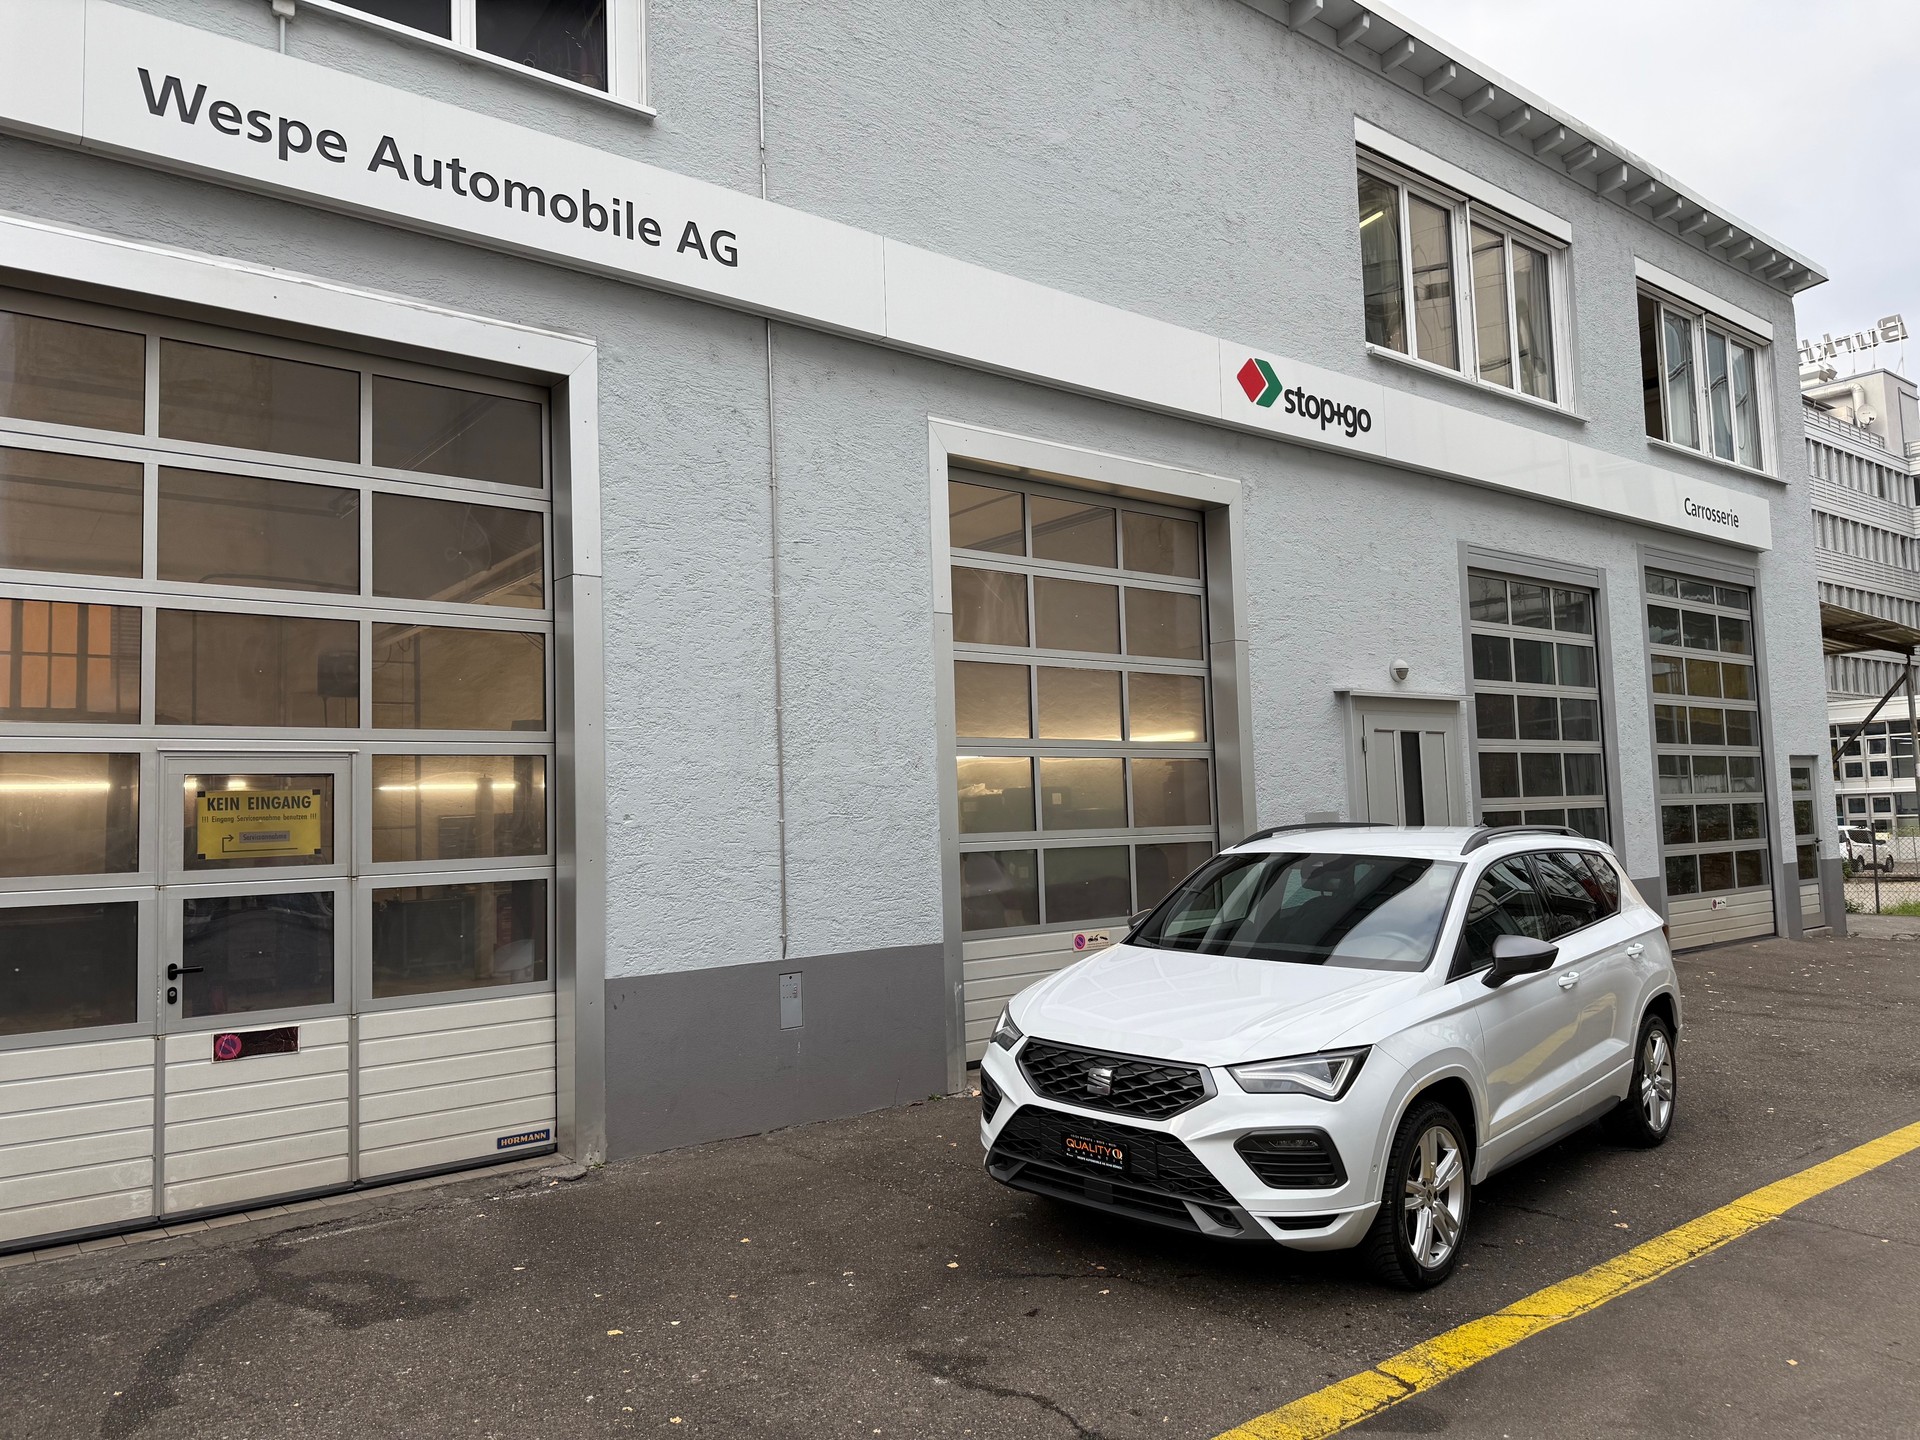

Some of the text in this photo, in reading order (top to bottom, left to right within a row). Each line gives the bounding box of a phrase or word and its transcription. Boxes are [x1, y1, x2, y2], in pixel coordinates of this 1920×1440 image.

[137, 66, 739, 268] Wespe Automobile AG
[1284, 386, 1372, 438] stop+go
[1684, 497, 1740, 528] Carrosserie
[207, 795, 312, 811] KEIN EINGANG
[211, 815, 235, 824] Eingang
[236, 813, 281, 822] Serviceannahme
[283, 813, 308, 821] benutzen
